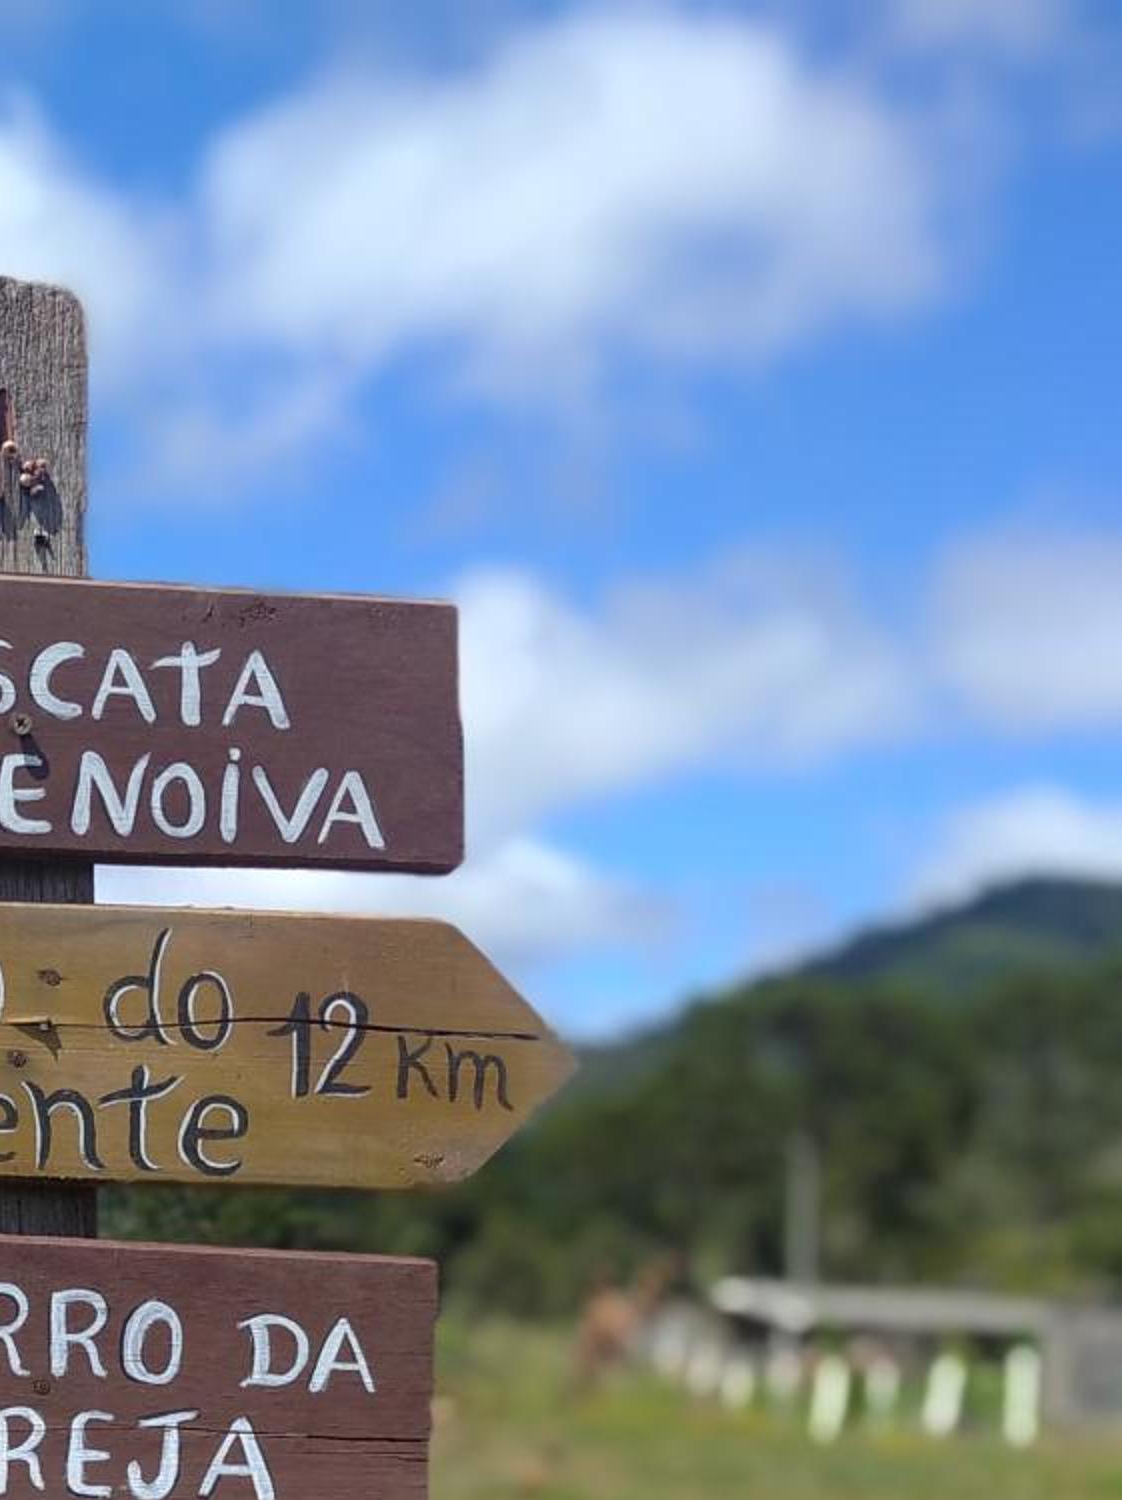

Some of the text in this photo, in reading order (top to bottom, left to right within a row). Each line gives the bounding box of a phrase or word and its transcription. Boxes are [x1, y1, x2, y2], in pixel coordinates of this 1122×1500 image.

[103, 928, 233, 1052] do
[266, 990, 372, 1099] 12
[239, 1315, 376, 1394] DA
